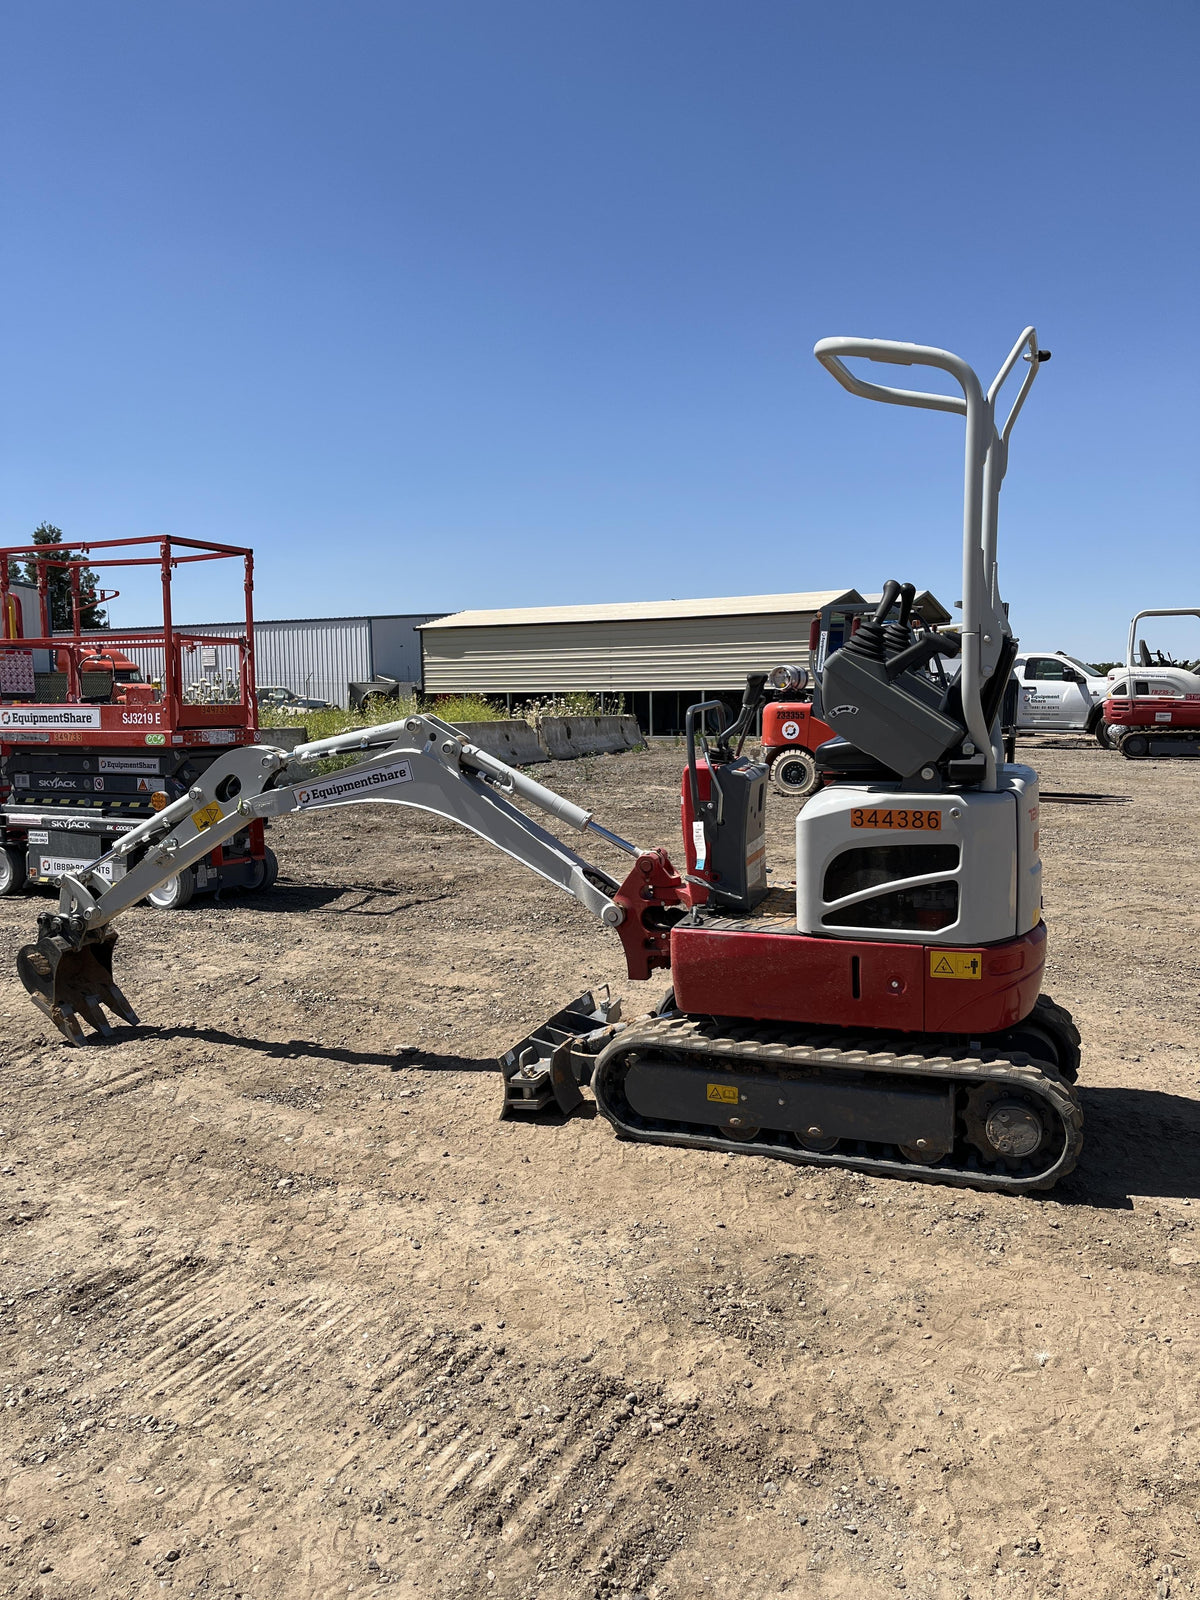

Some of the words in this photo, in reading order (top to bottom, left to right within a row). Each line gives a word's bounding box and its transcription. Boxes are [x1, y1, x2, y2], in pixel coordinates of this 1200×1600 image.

[12, 713, 92, 725] EquipmentShare
[122, 712, 153, 724] SJ3219
[155, 713, 161, 724] E
[776, 711, 805, 720] 233355
[54, 733, 82, 742] 349733
[106, 761, 157, 770] EquipmentShare
[38, 777, 76, 788] SKYJACK
[310, 768, 407, 799] EquipmentShare
[51, 818, 91, 829] SKYJACK
[853, 809, 939, 829] 344386
